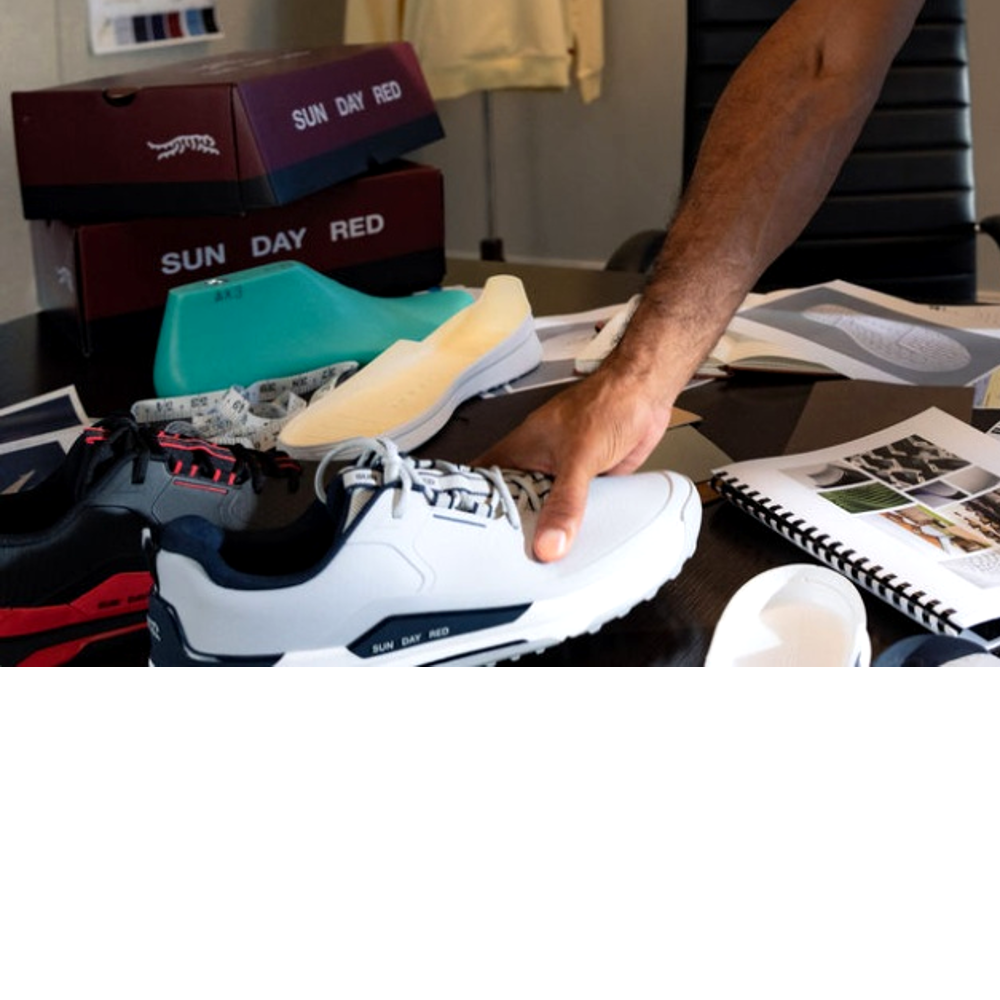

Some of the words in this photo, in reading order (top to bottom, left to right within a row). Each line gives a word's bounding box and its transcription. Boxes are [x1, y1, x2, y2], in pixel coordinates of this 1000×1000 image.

[291, 101, 329, 131] SUN
[334, 90, 366, 117] DAY
[371, 80, 403, 105] RED
[160, 243, 226, 275] SUN
[251, 227, 307, 257] DAY
[329, 213, 385, 242] RED
[372, 639, 396, 655] SUN
[401, 632, 422, 647] DAY
[428, 625, 451, 640] RED
